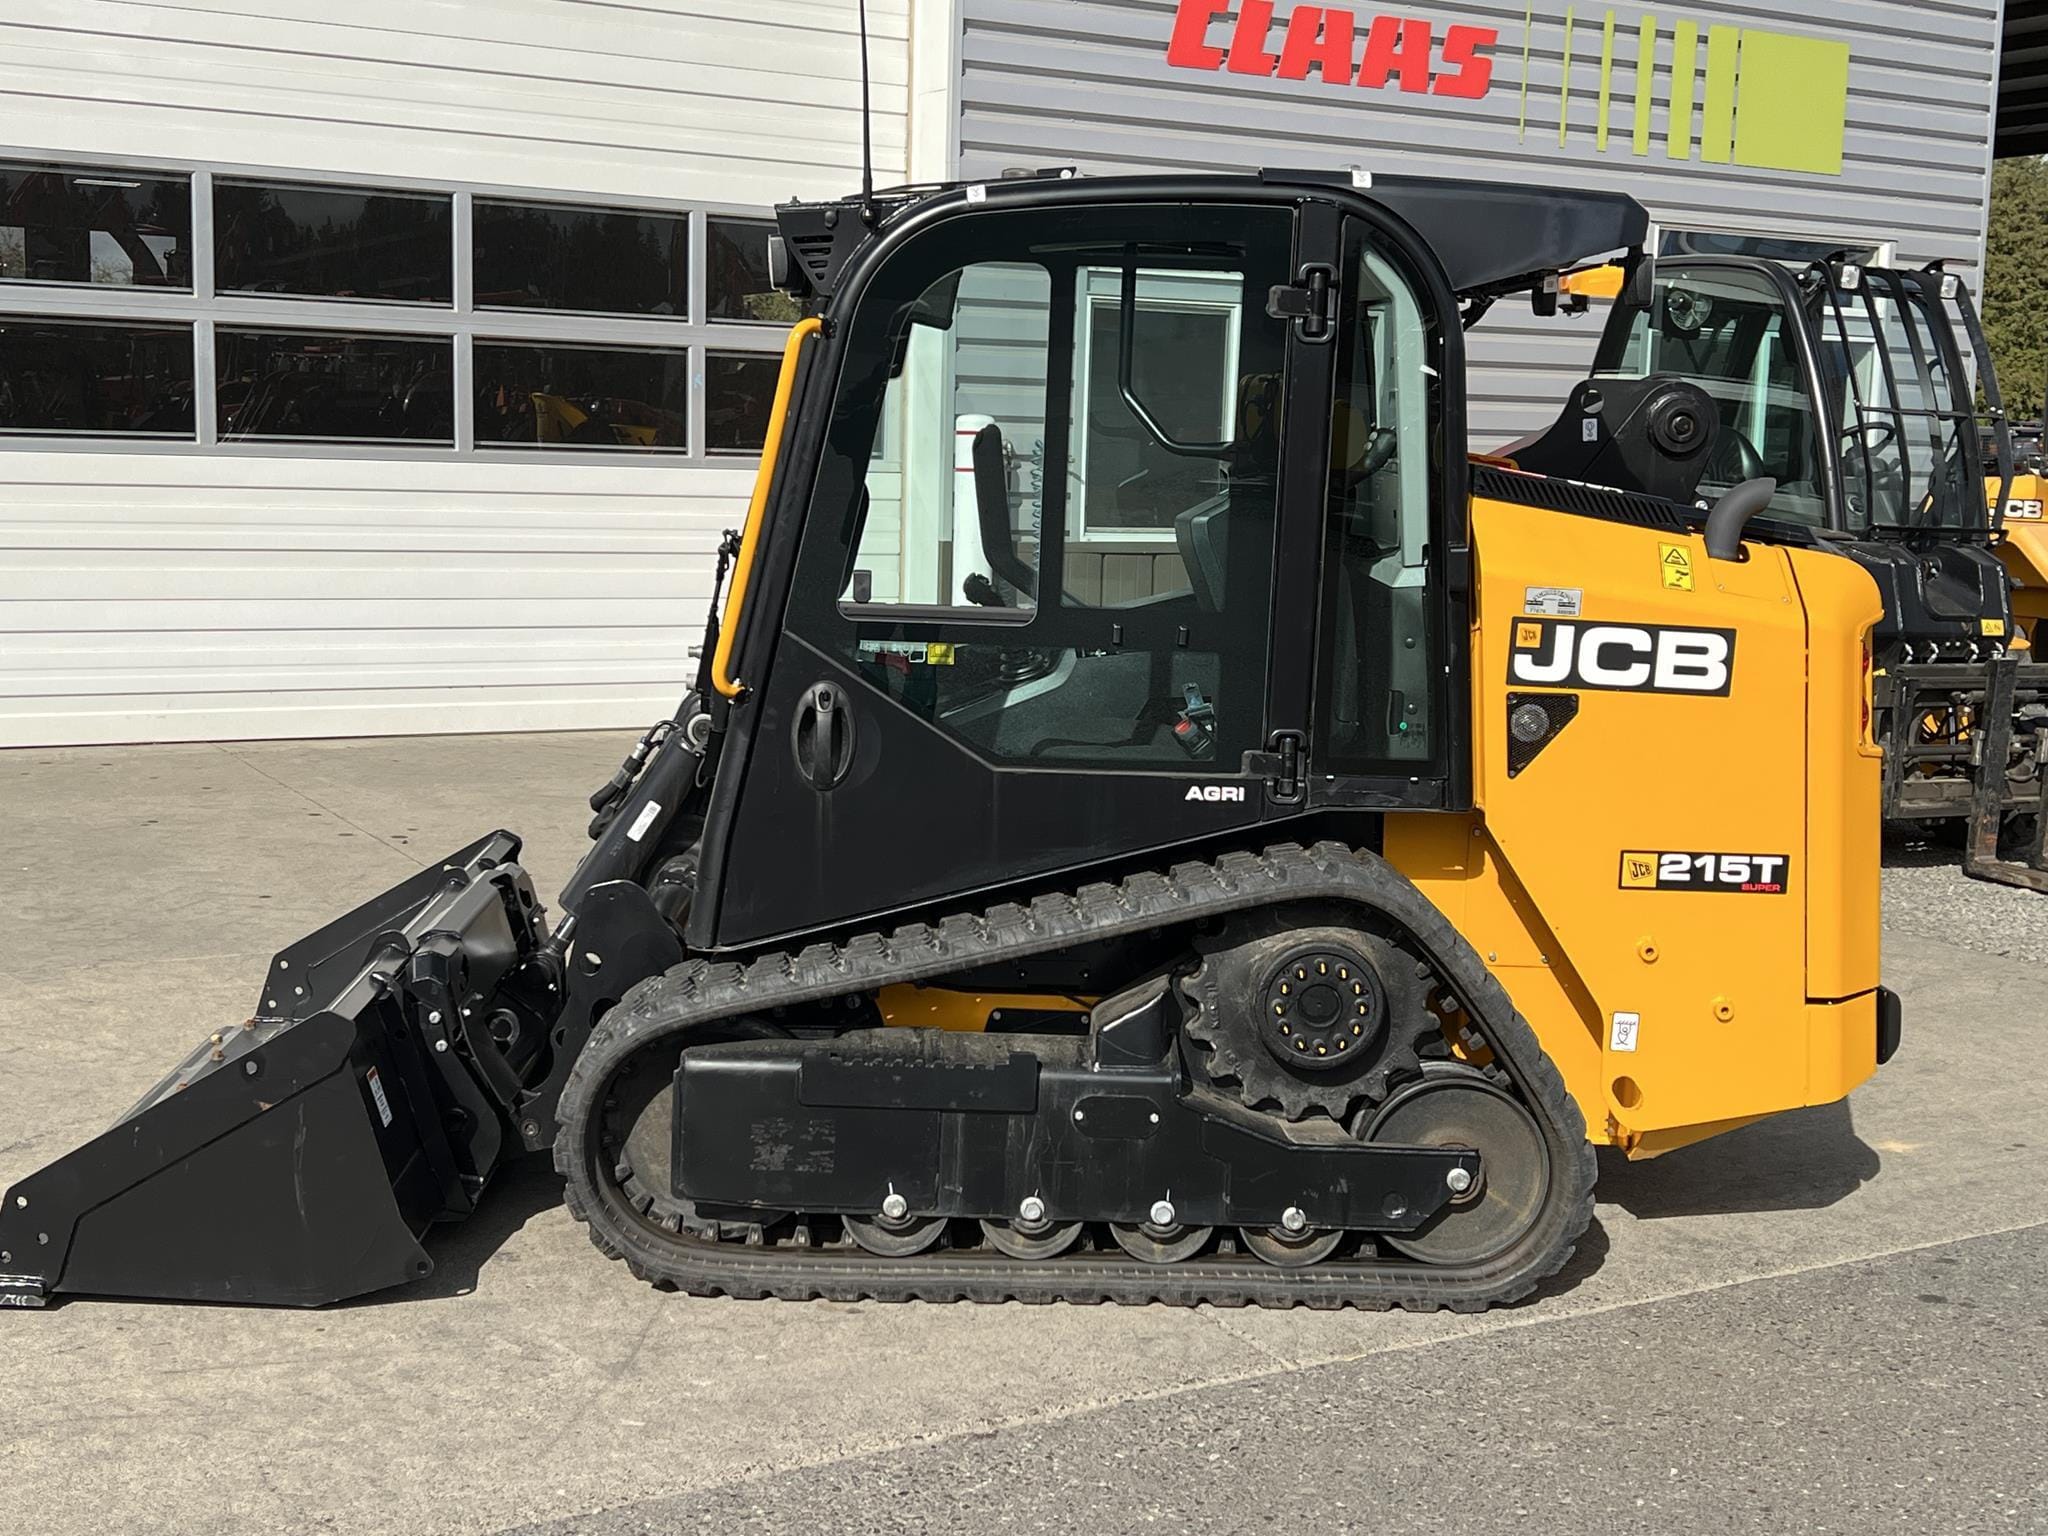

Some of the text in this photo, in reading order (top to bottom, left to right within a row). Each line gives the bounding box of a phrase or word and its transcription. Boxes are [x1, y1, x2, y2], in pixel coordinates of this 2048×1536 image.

[1167, 0, 1499, 99] CLAAS
[1514, 624, 1728, 691] JCB
[1184, 785, 1245, 801] AGRI
[1631, 853, 1784, 884] JCB 215T
[1741, 883, 1781, 892] SUPER
